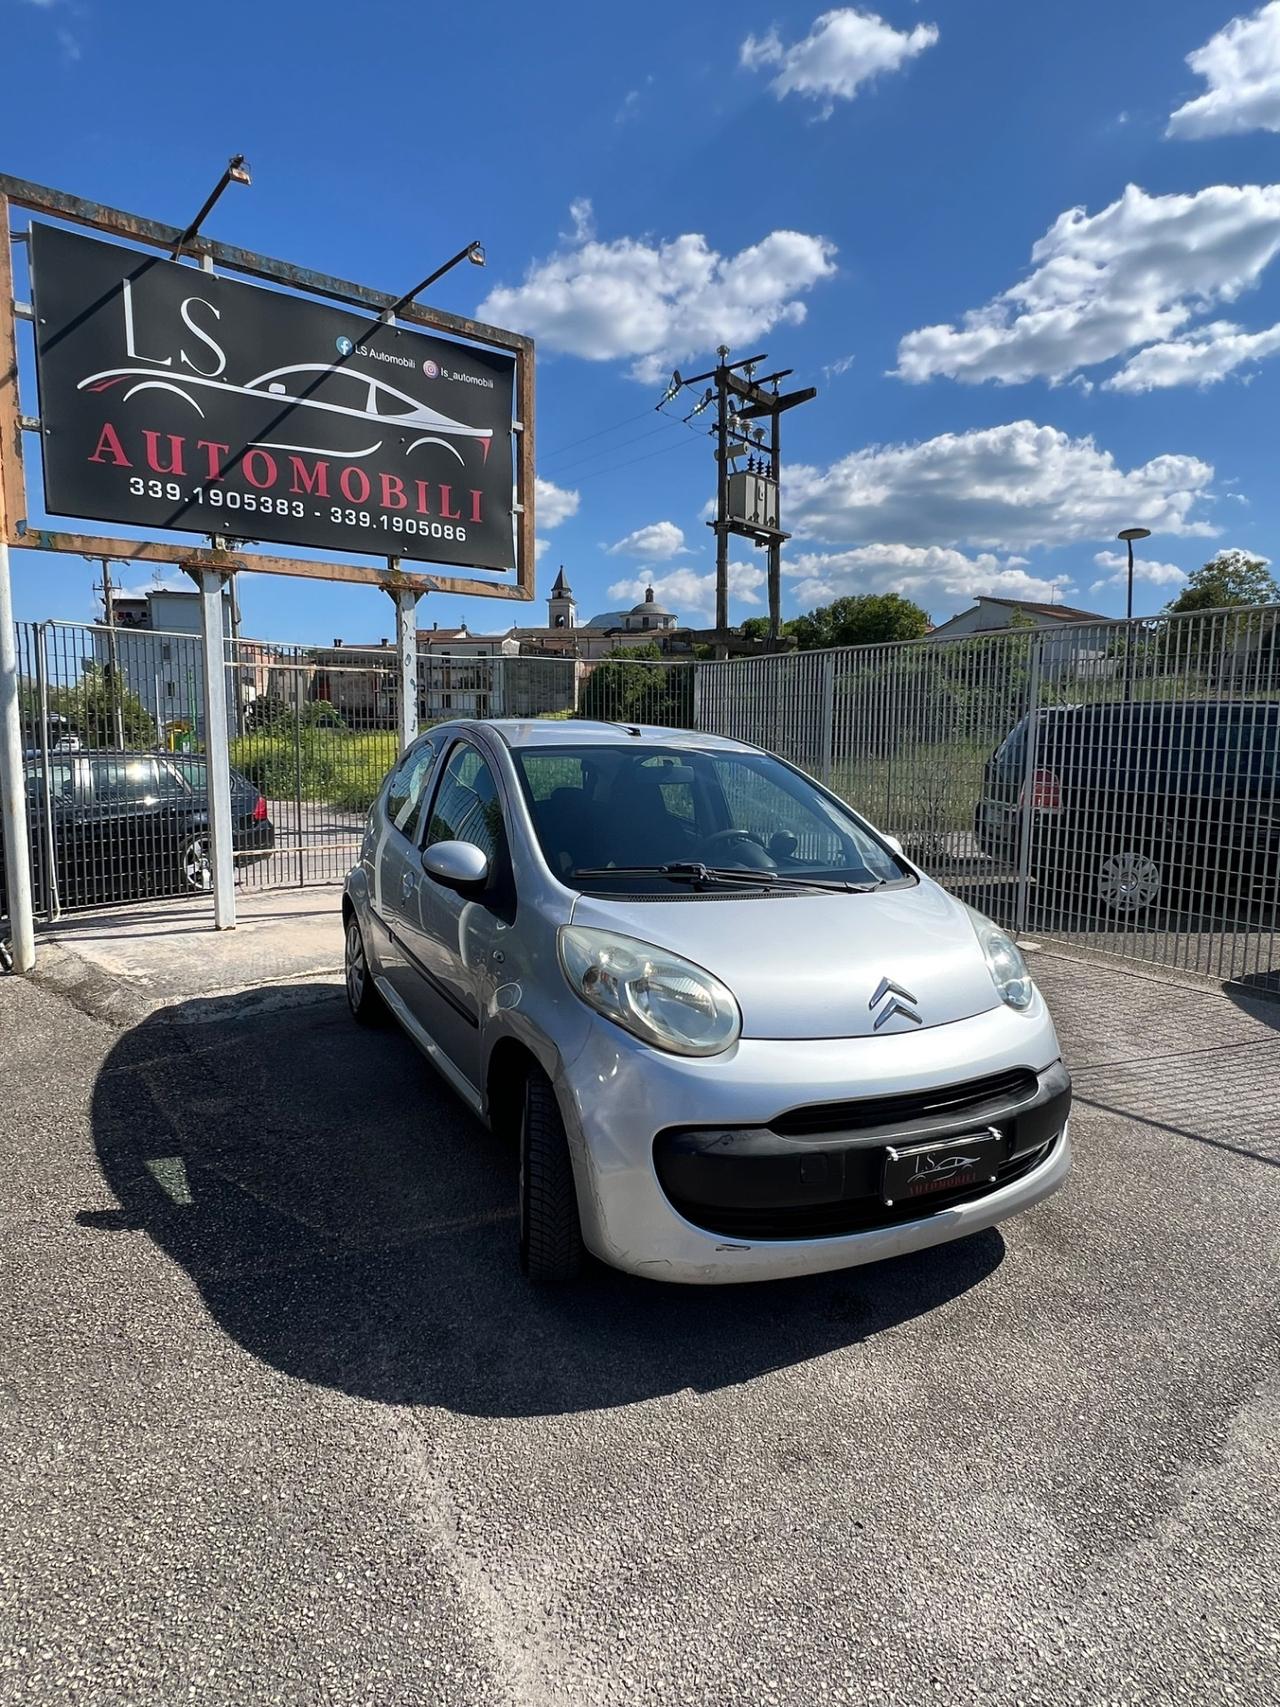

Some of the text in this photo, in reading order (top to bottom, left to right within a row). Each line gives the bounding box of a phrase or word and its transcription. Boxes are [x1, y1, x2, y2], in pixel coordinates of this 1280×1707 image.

[123, 278, 226, 377] LS
[355, 344, 416, 369] LS Automobili
[88, 422, 483, 523] AUTOMOBILI
[129, 477, 305, 518] 339.1905383
[330, 507, 467, 541] 339.1905086
